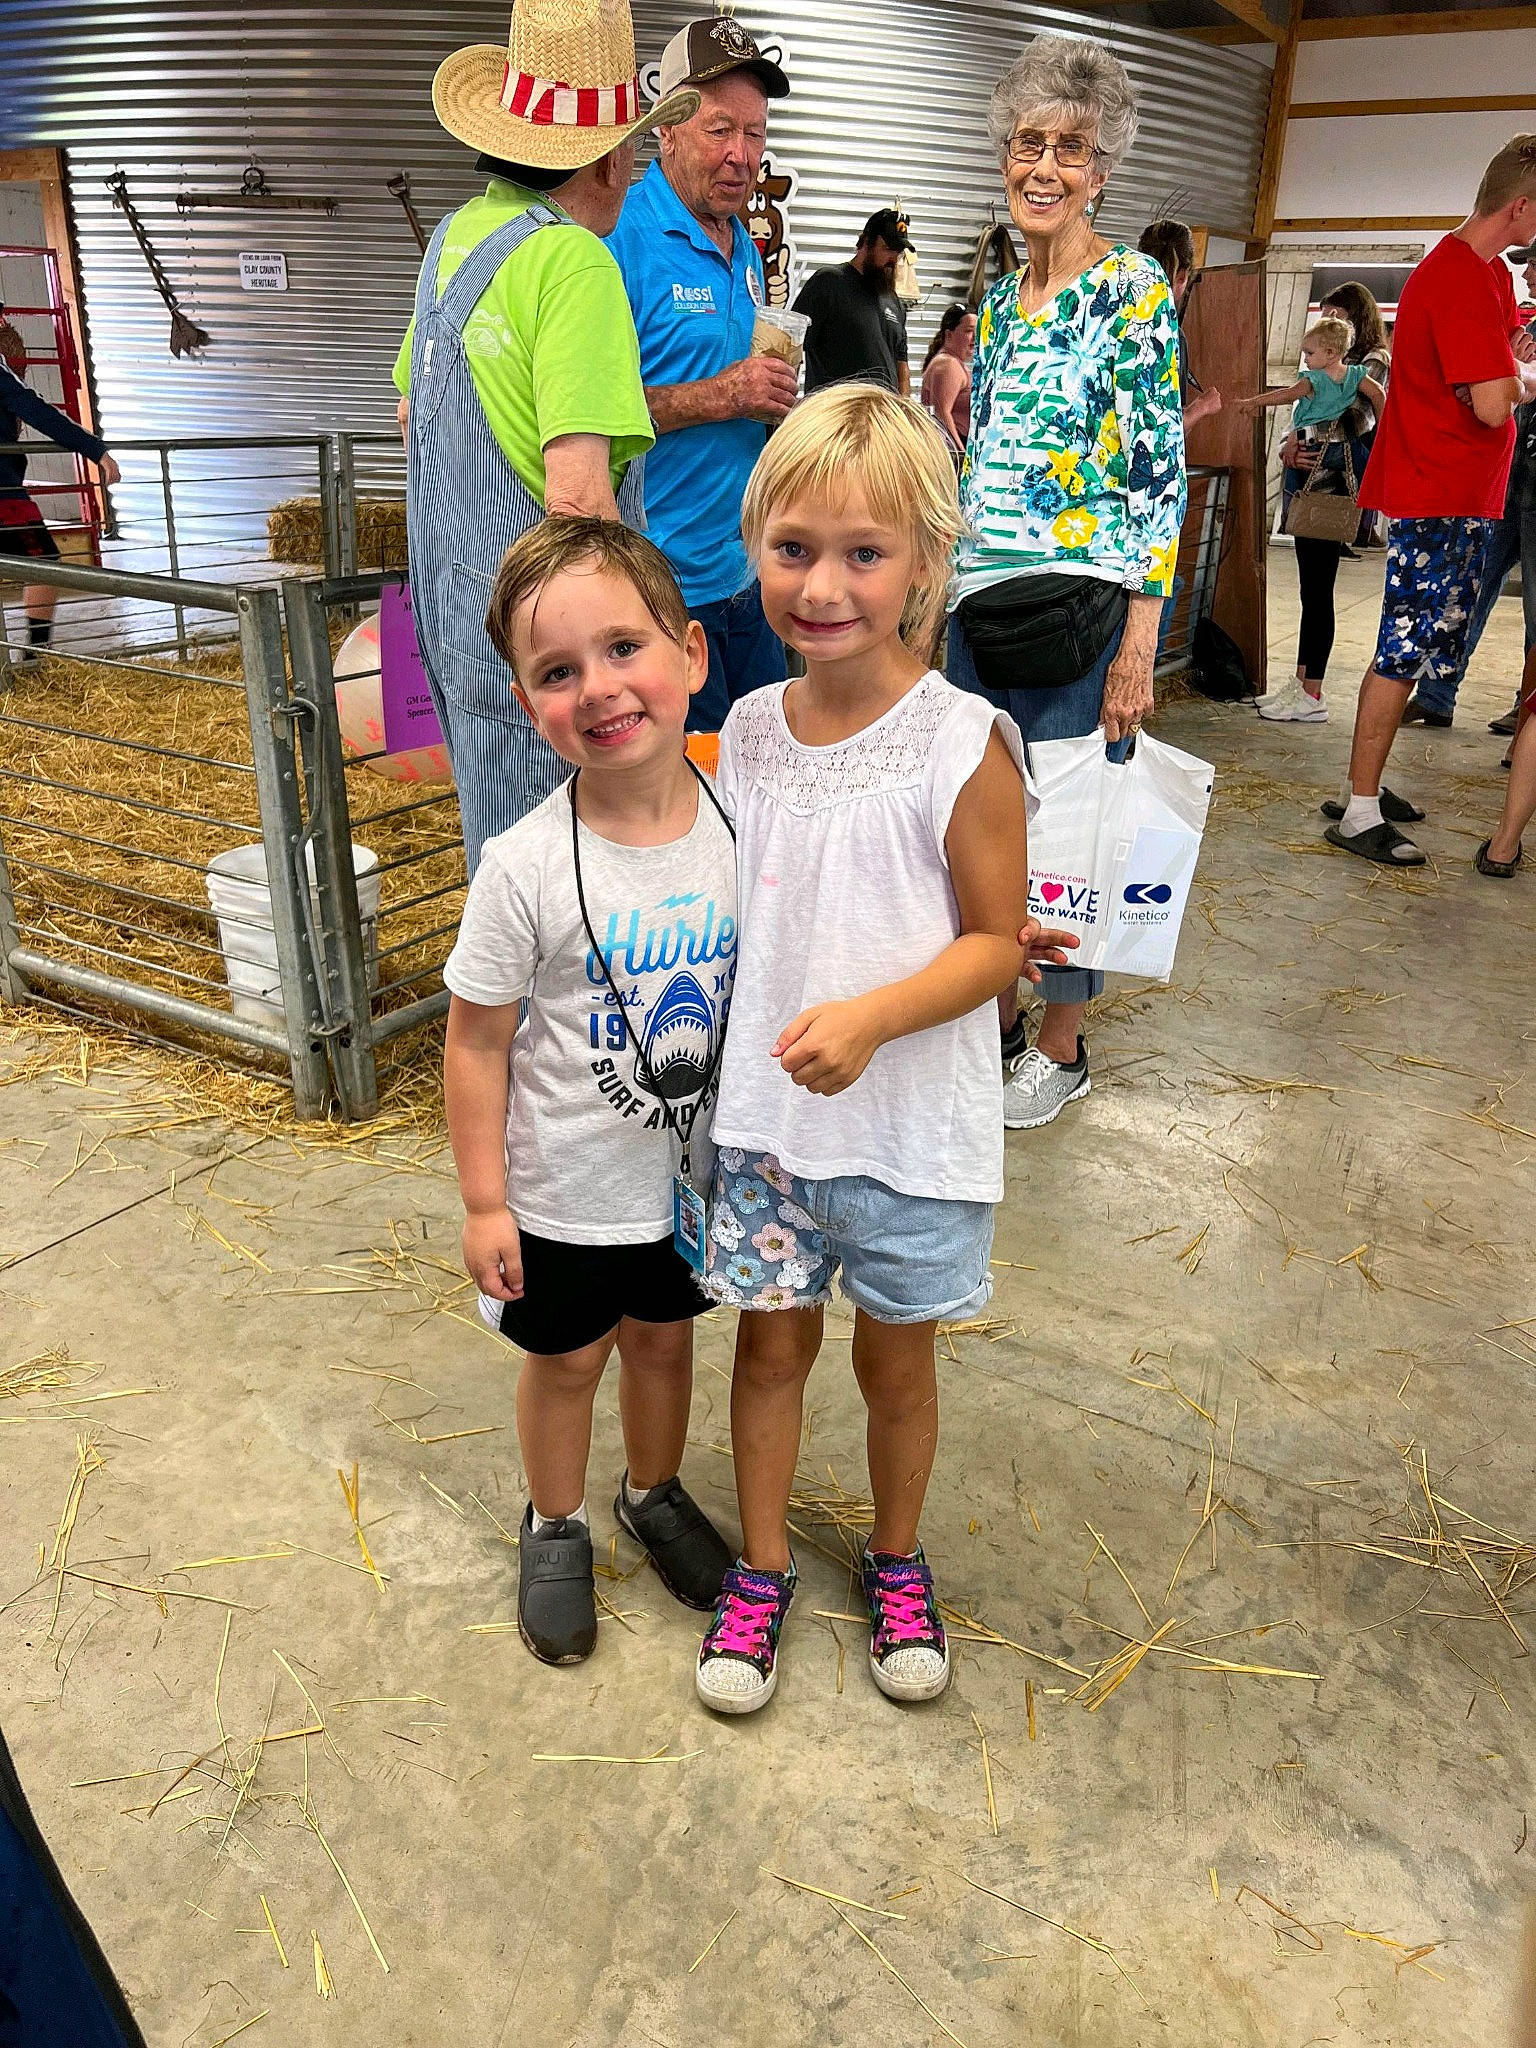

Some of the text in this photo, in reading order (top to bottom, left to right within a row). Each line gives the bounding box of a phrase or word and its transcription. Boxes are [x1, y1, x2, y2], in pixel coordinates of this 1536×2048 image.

[244, 265, 282, 275] CLAY COUNTY
[250, 279, 279, 288] HERITAGE
[1030, 868, 1087, 885] kinetico.com
[1058, 908, 1097, 925] WATER
[1119, 910, 1169, 921] Kinetico
[586, 901, 738, 985] Hurle
[590, 1057, 646, 1119] SURF
[643, 1102, 694, 1130] AND
